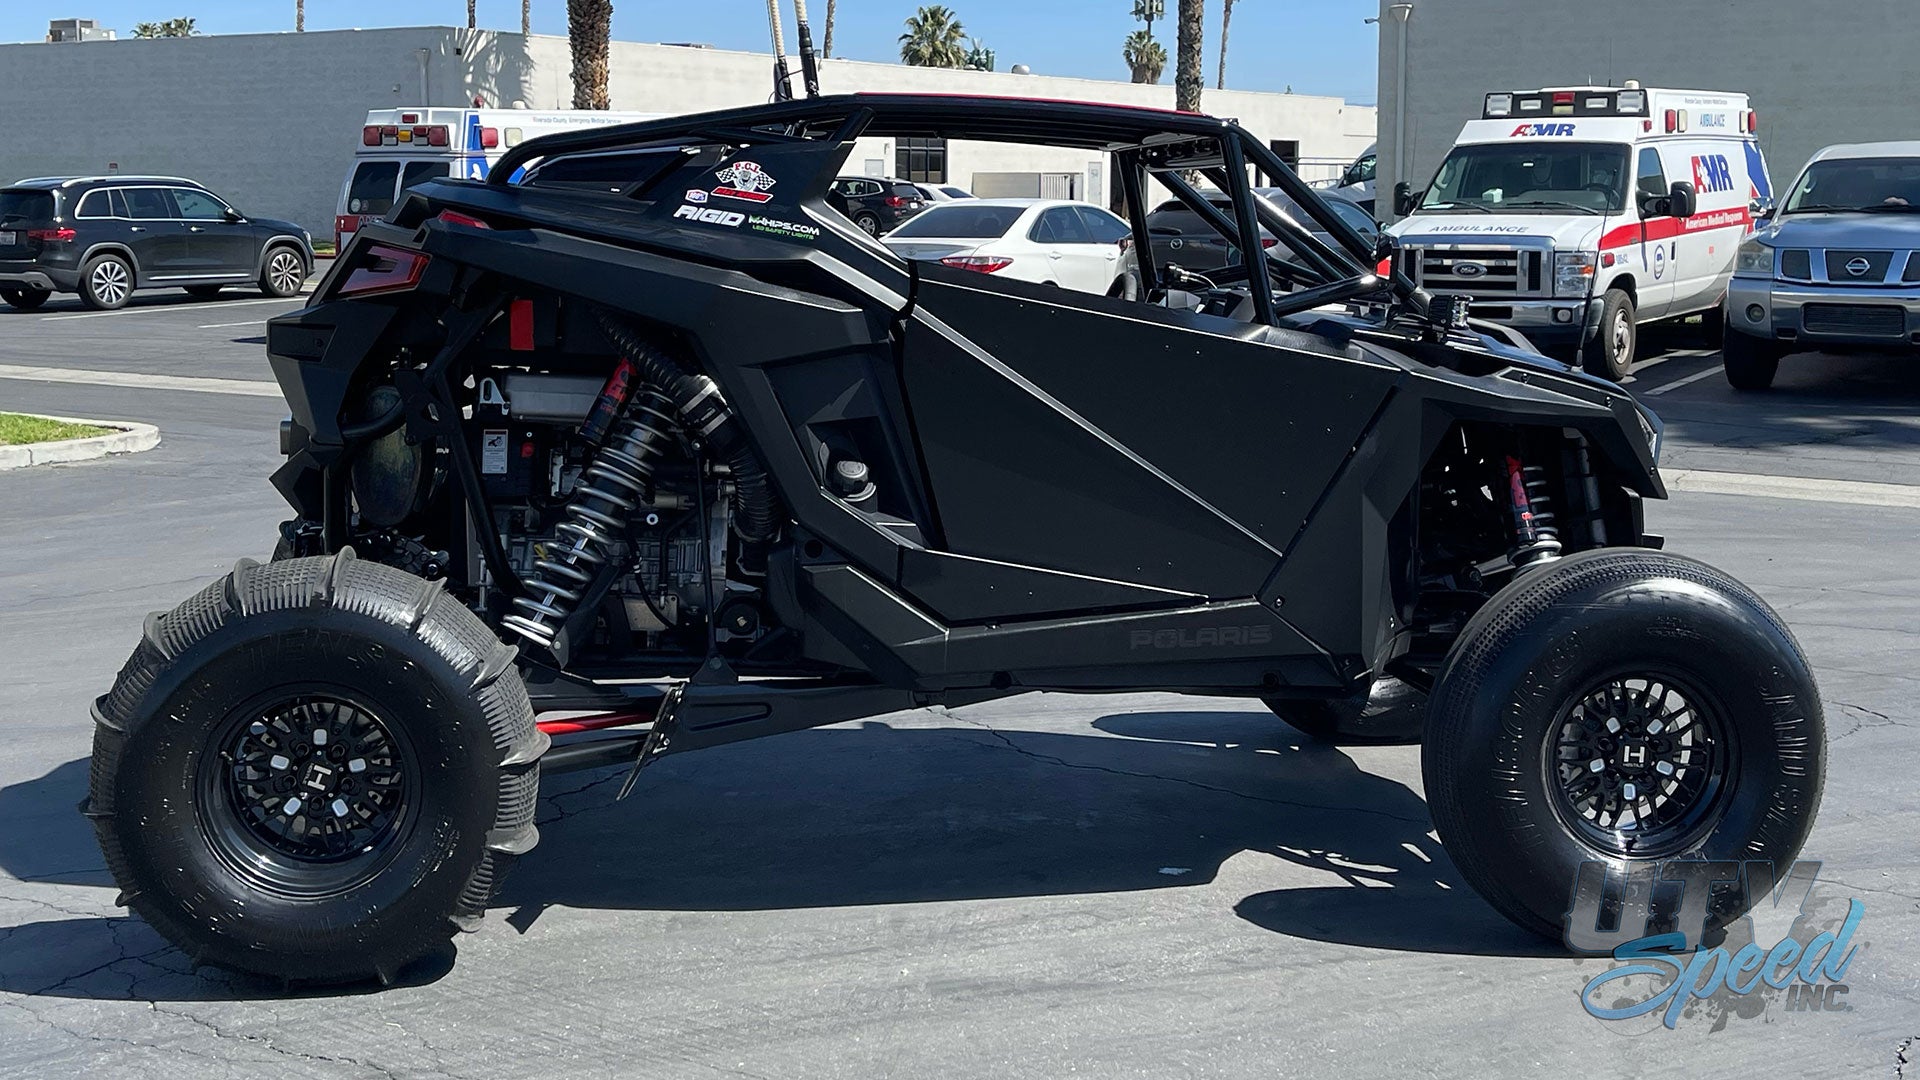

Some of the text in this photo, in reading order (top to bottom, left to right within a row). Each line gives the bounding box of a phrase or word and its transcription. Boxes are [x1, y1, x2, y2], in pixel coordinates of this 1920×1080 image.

[1699, 113, 1725, 128] AMBULANCE
[1509, 123, 1576, 138] AMR
[1690, 154, 1734, 194] AMR
[673, 204, 745, 227] RIGID
[1685, 211, 1743, 230] American Medical Response
[765, 226, 790, 235] SAFETY
[791, 231, 815, 240] LIGHTS
[1428, 225, 1530, 233] AMBULANCE
[1129, 623, 1273, 650] POLARIS
